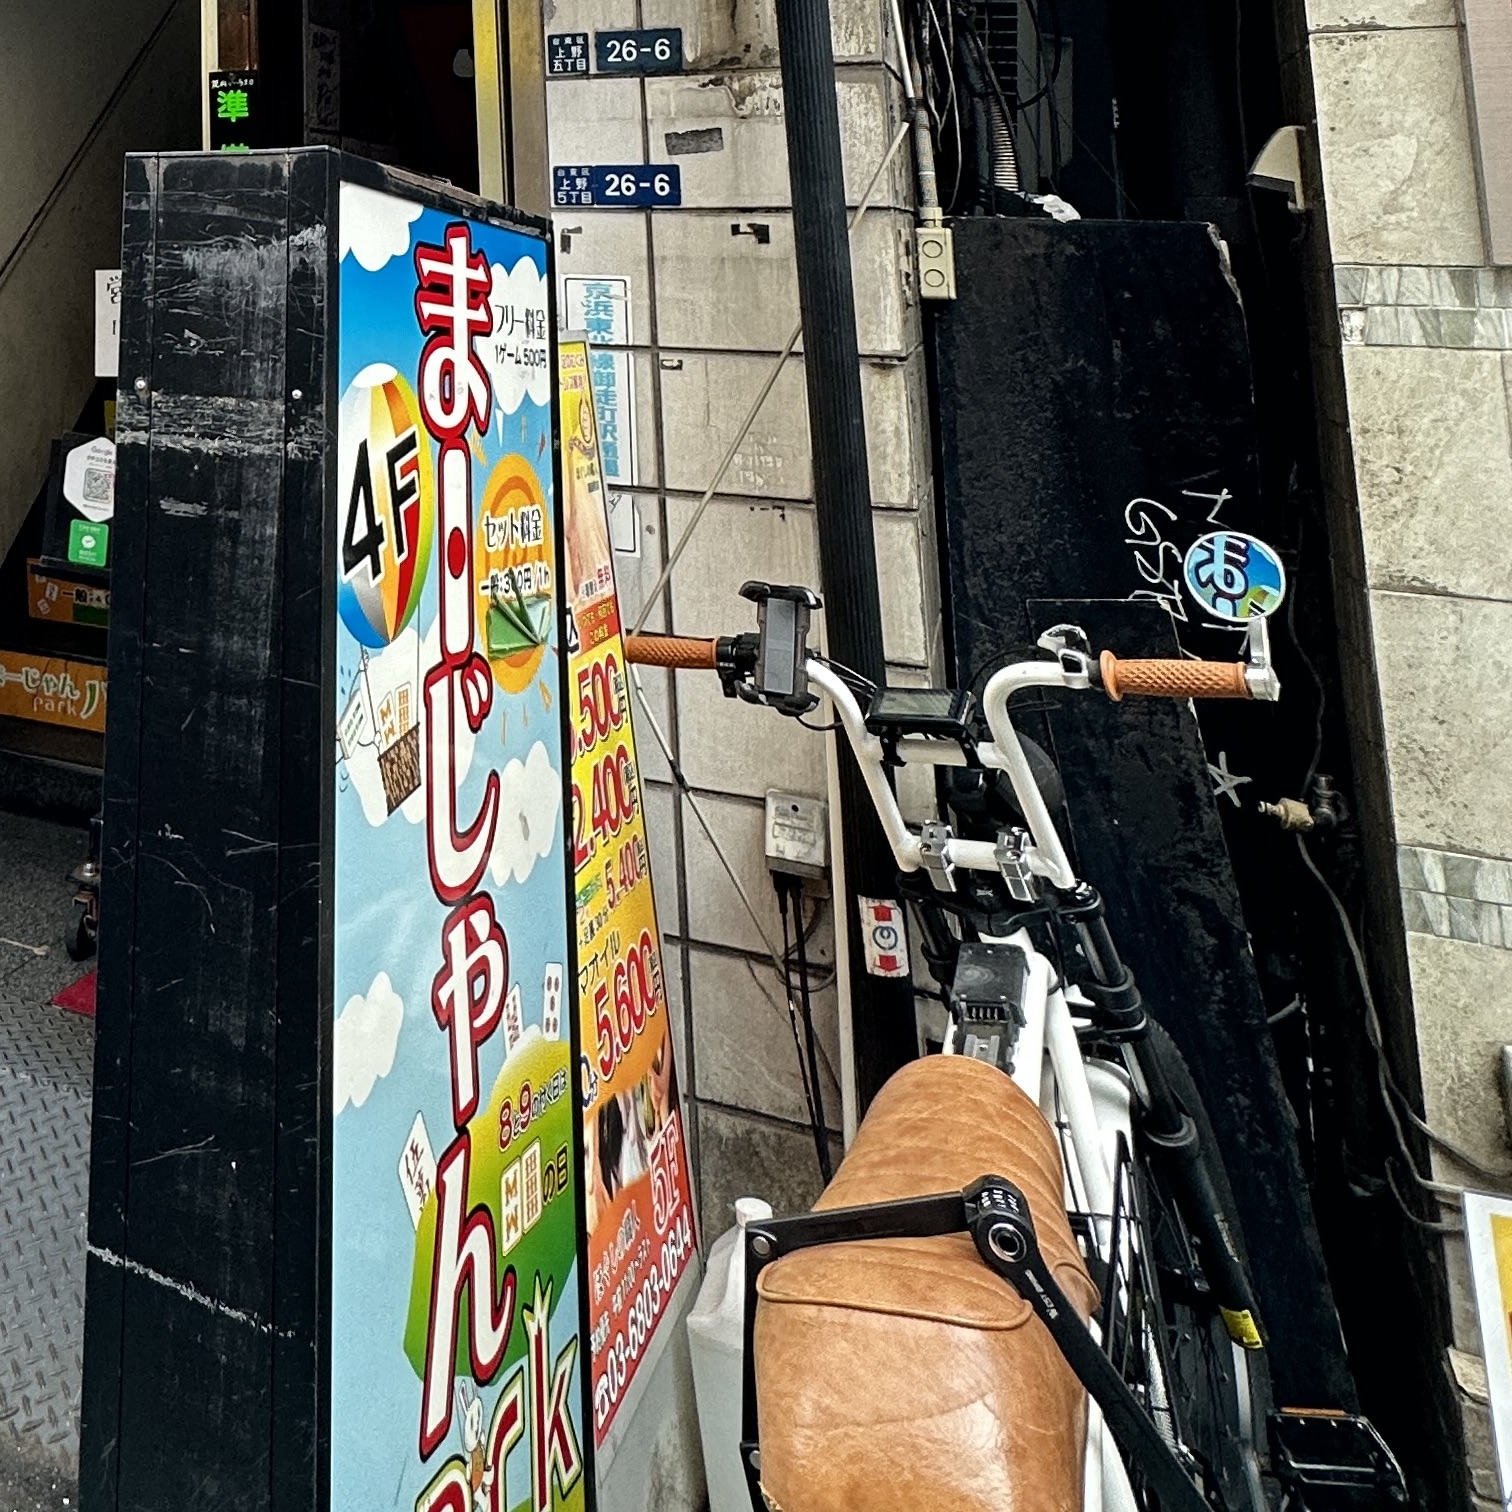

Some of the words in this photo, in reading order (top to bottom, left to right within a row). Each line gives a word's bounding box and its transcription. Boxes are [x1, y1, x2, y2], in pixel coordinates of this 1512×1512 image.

[555, 46, 583, 59] 上野
[606, 38, 672, 63] 26-6
[553, 59, 587, 73] 五丁目
[559, 176, 588, 191] 上野
[604, 173, 671, 197] 26-6
[557, 191, 593, 205] 5丁目
[494, 303, 547, 341] フリー料金
[523, 347, 547, 369] 500円
[342, 425, 421, 586] 4F
[483, 507, 543, 549] セット料金
[414, 221, 516, 1464] まーじゃん
[649, 1109, 681, 1238] 5F
[606, 1203, 692, 1404] 03-6803-0644
